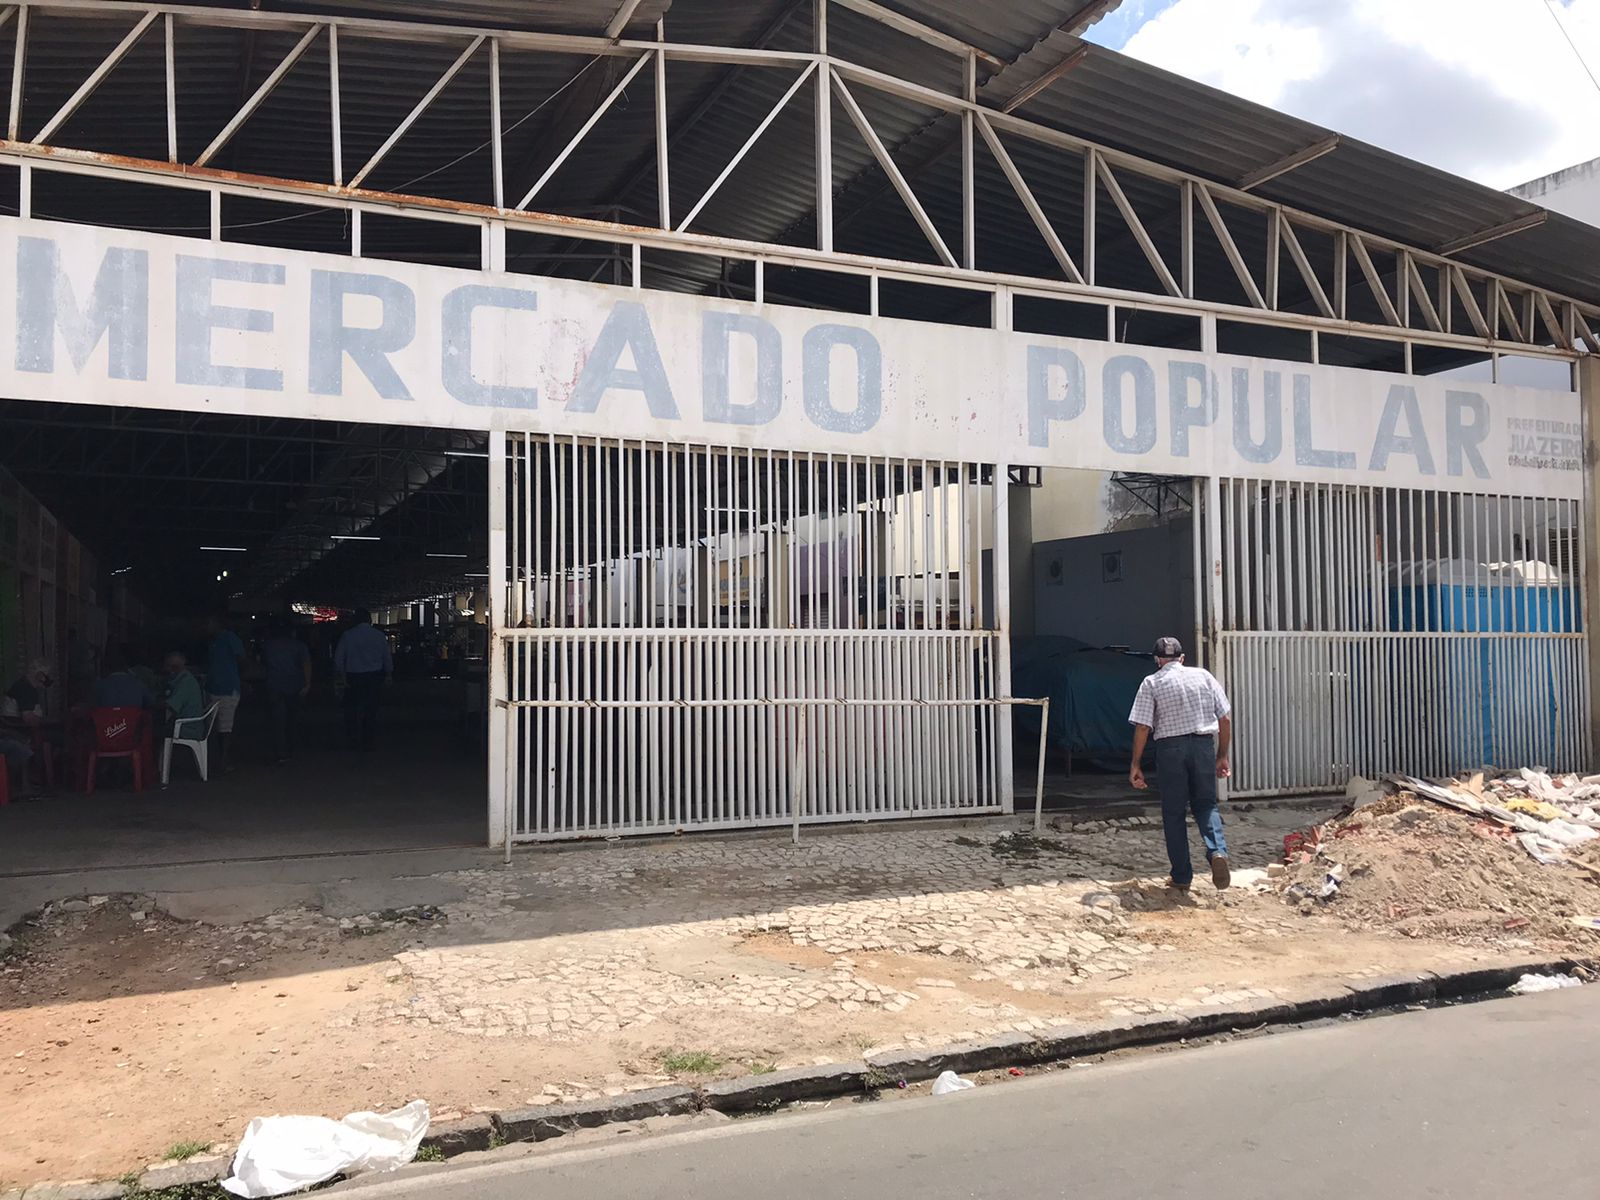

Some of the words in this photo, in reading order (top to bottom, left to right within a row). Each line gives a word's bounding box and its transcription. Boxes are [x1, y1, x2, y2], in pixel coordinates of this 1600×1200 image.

[15, 235, 882, 434] MERCADO
[1026, 344, 1492, 479] POPULAR
[1507, 417, 1571, 435] PREFEITURA
